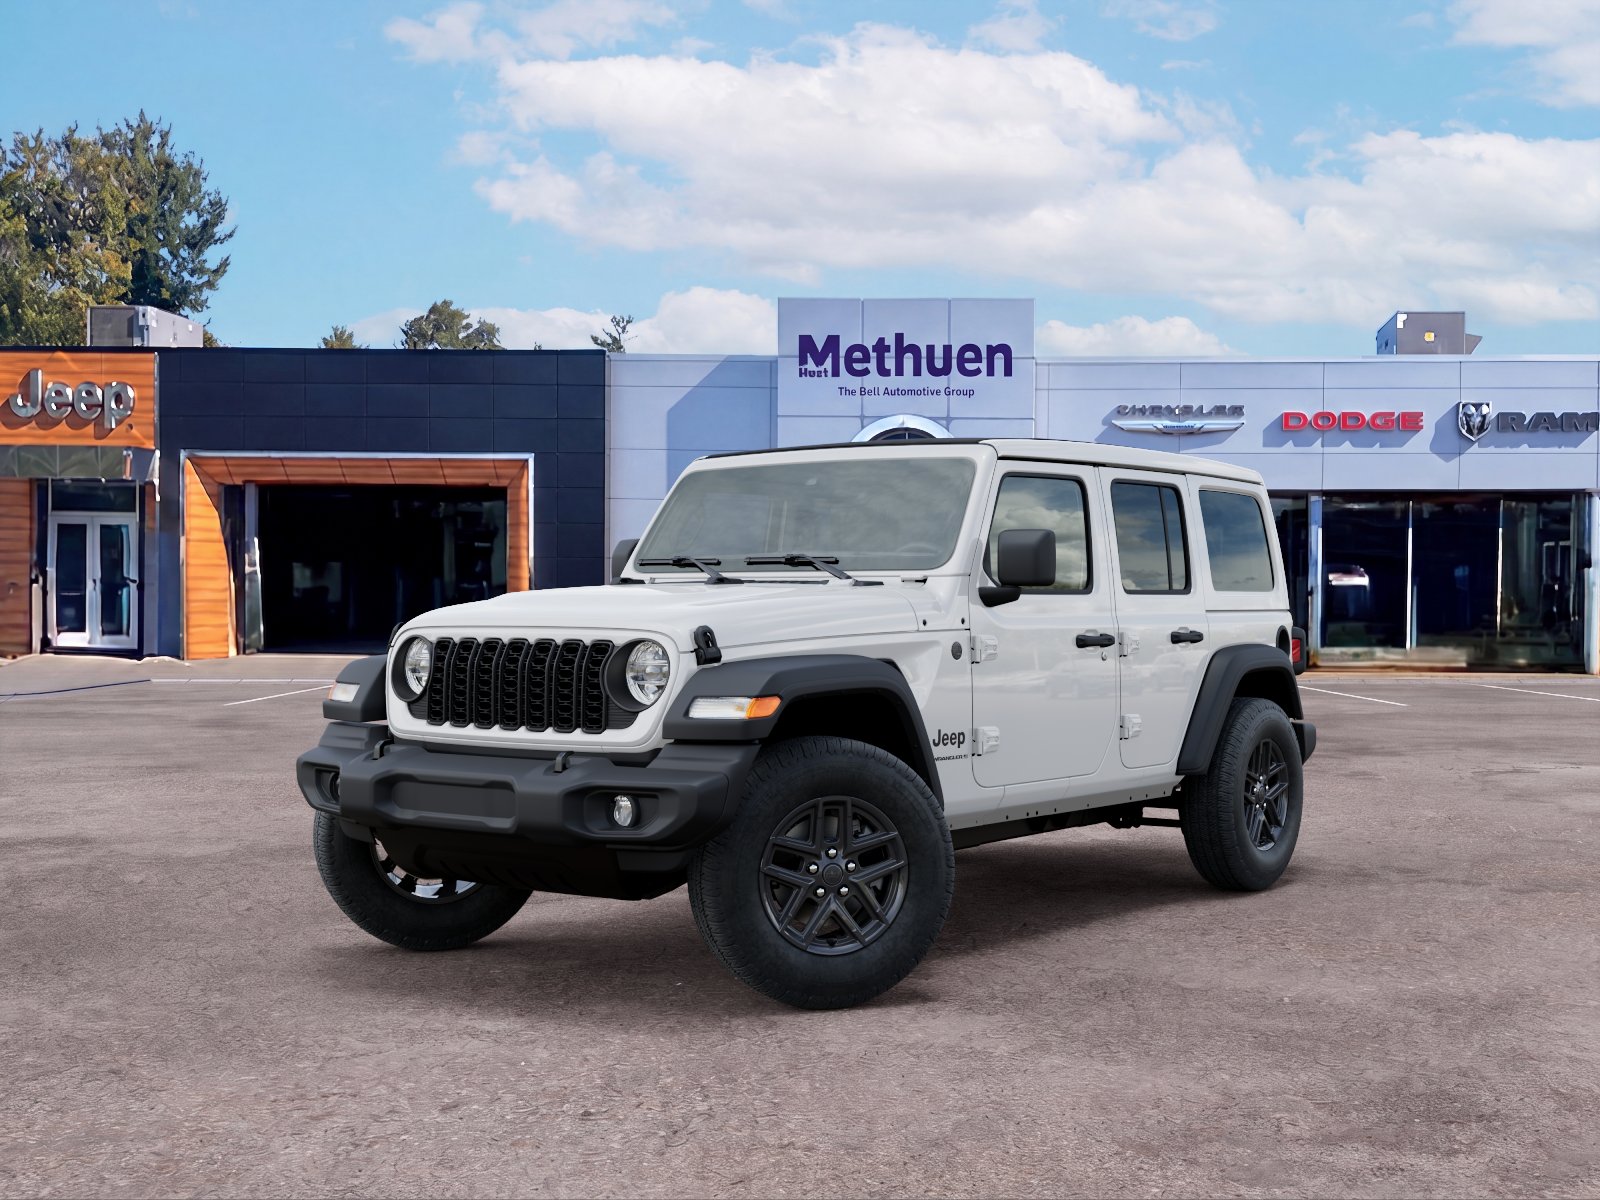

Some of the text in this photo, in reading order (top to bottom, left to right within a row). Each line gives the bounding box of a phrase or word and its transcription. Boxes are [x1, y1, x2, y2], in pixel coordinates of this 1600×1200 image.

[799, 332, 1013, 377] Methuen
[9, 368, 136, 430] Jeep
[838, 386, 975, 399] The Bell Automotive Group
[1282, 411, 1424, 431] DODGE
[1498, 411, 1600, 433] RAM
[932, 729, 966, 748] Jeep
